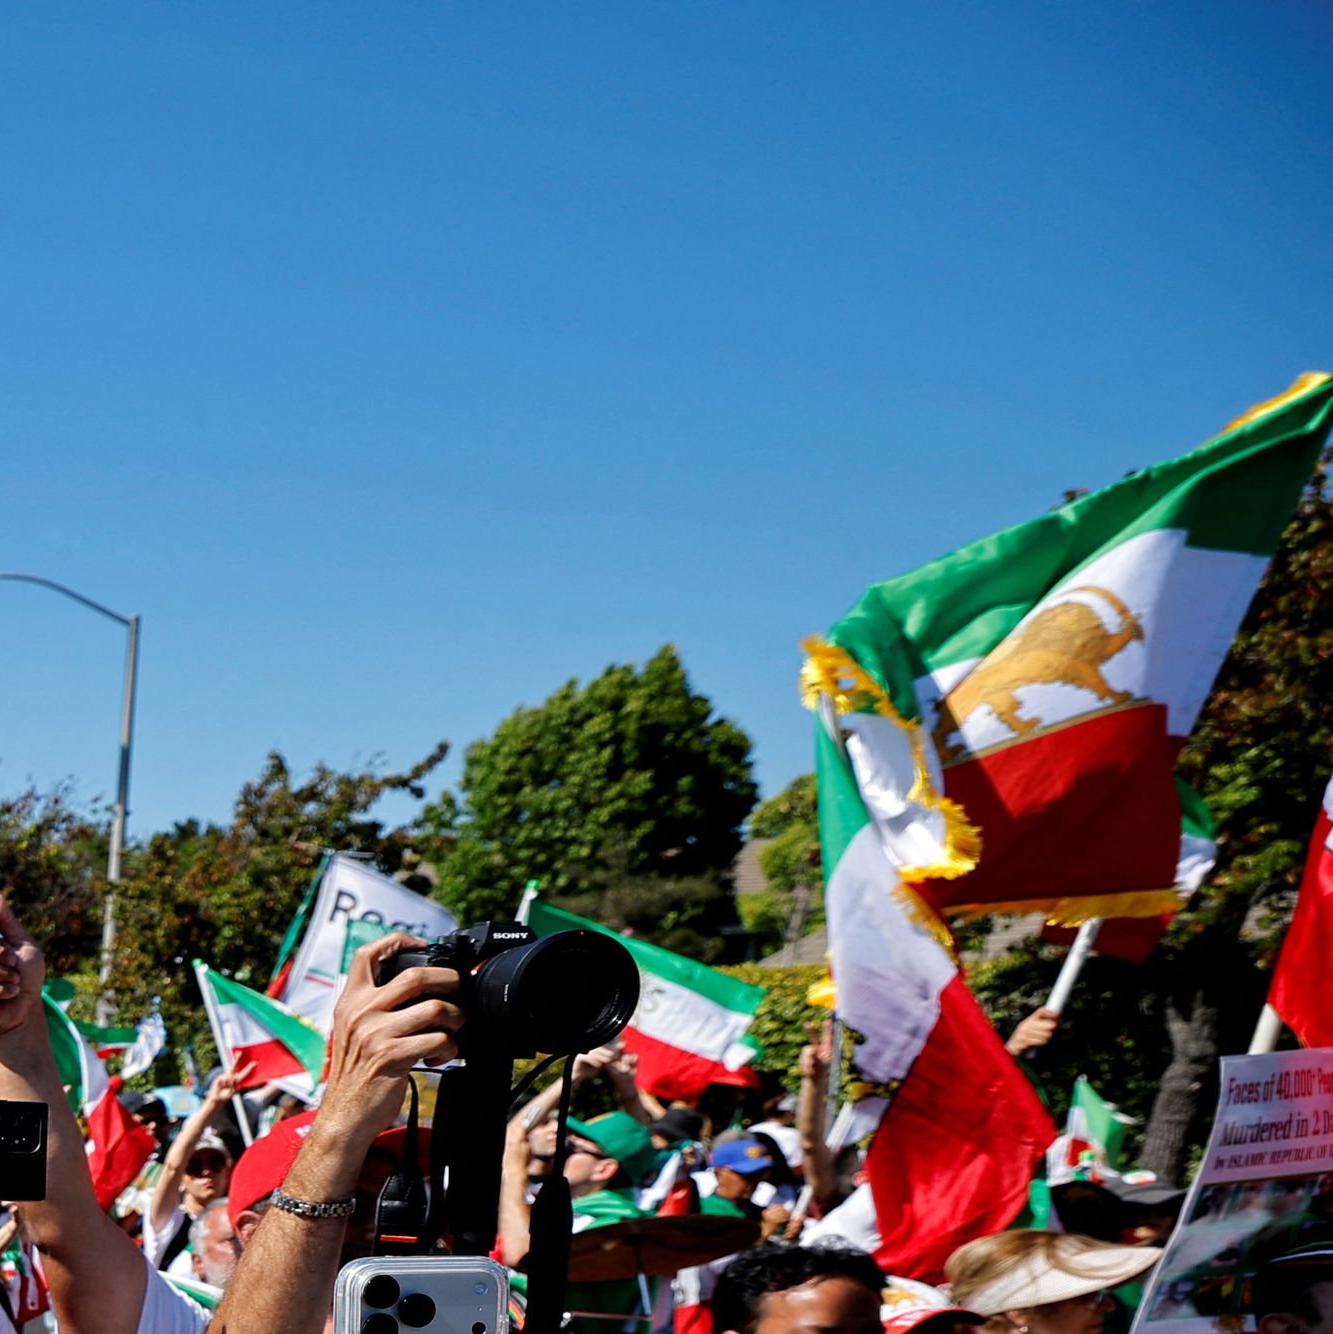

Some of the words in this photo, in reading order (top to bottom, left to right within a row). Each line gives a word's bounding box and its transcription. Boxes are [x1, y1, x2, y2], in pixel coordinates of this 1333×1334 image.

[492, 932, 528, 940] SONY
[1227, 1077, 1261, 1105] Faces
[1263, 1073, 1275, 1101] of
[1219, 1113, 1293, 1147] Murdered
[1295, 1112, 1309, 1138] in
[1312, 1110, 1320, 1136] 2
[1228, 1151, 1265, 1168] ISLAMIC
[1269, 1147, 1314, 1164] REPUBLIC
